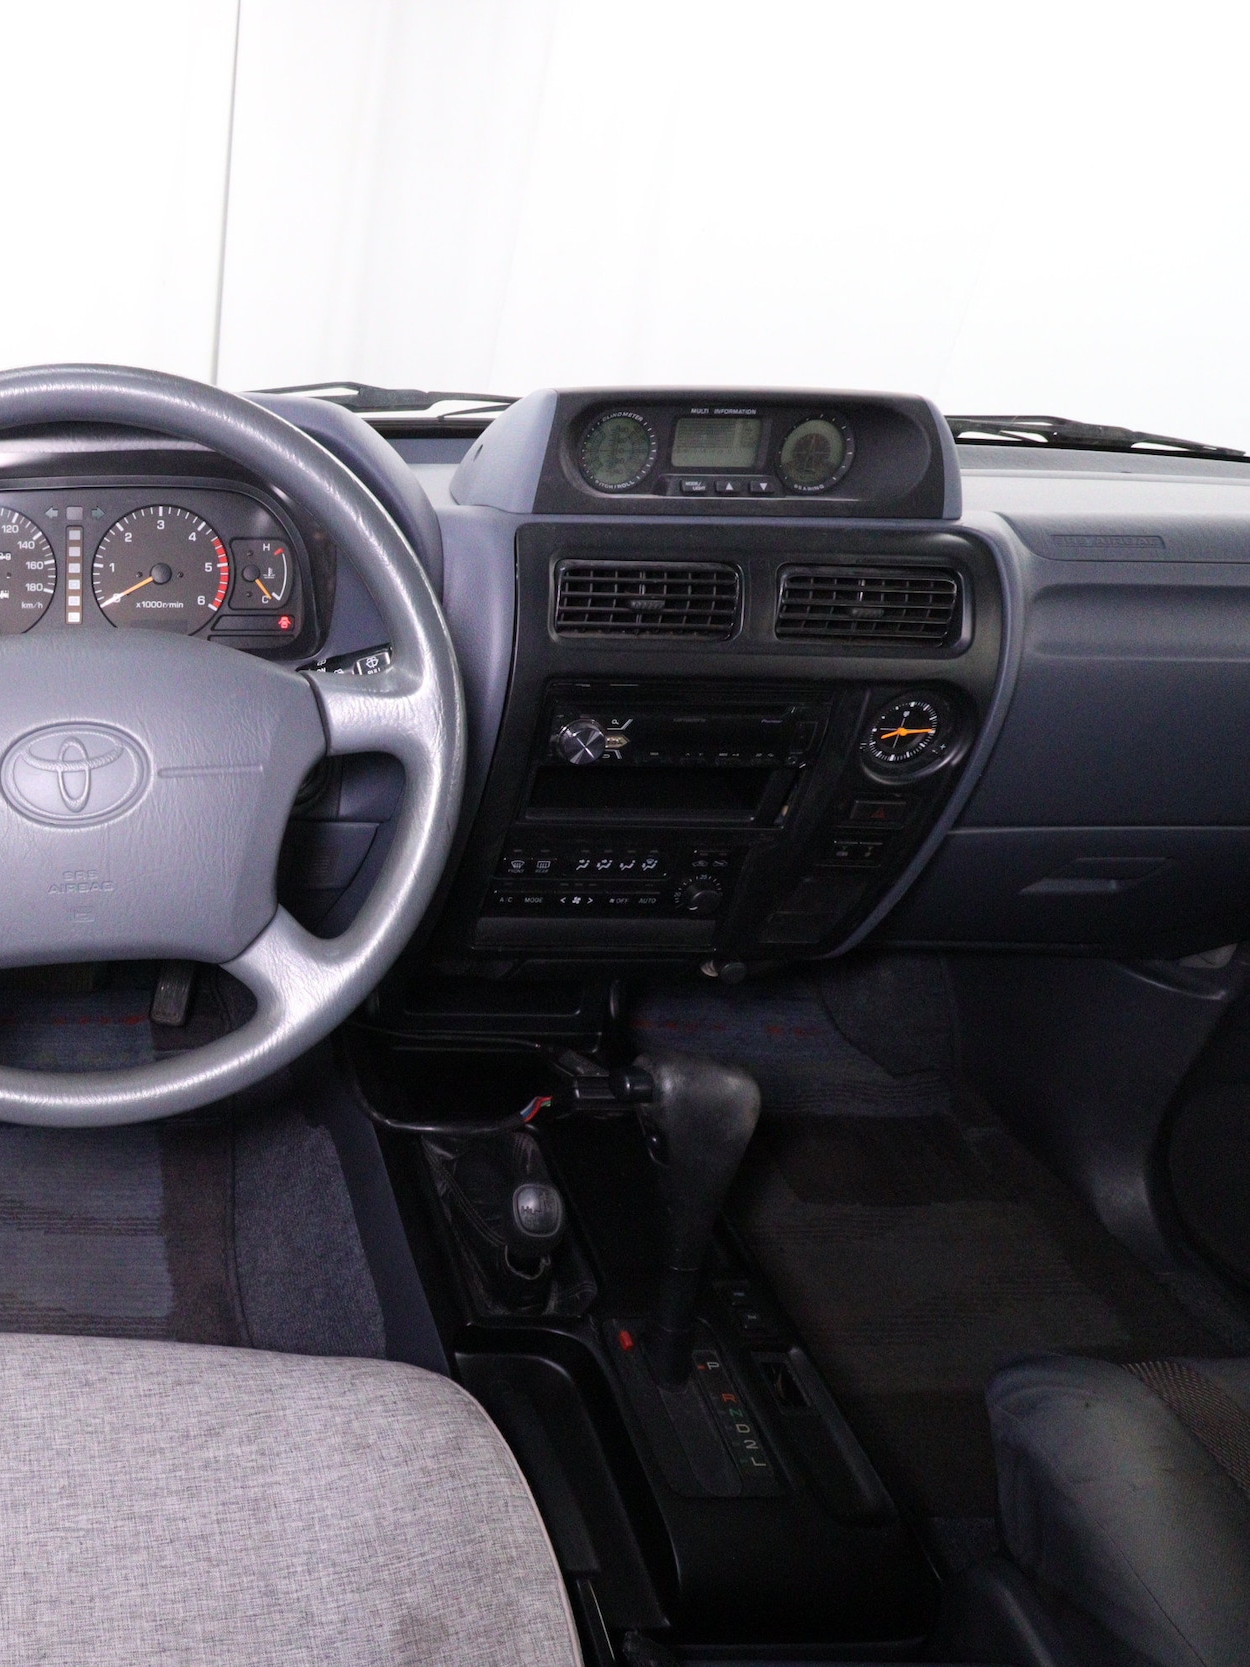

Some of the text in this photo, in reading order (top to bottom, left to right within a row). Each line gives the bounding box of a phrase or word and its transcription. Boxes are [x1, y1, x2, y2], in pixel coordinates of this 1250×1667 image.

[1, 524, 19, 534] 120
[156, 520, 165, 530] 3
[124, 532, 133, 543] 2
[188, 532, 197, 542] 4
[17, 540, 35, 550] 140
[262, 543, 270, 551] H
[25, 561, 43, 570] 160
[109, 562, 115, 572] 1
[204, 562, 213, 572] 5
[25, 583, 43, 592] 180
[197, 595, 206, 605] 6
[261, 595, 269, 604] C
[21, 601, 43, 609] km/h
[62, 869, 99, 882] SRS
[47, 880, 116, 895] AIRBAG
[706, 1361, 720, 1371] P
[729, 1408, 744, 1418] N
[735, 1423, 751, 1434] D
[743, 1439, 759, 1450] 2
[751, 1456, 767, 1467] L
